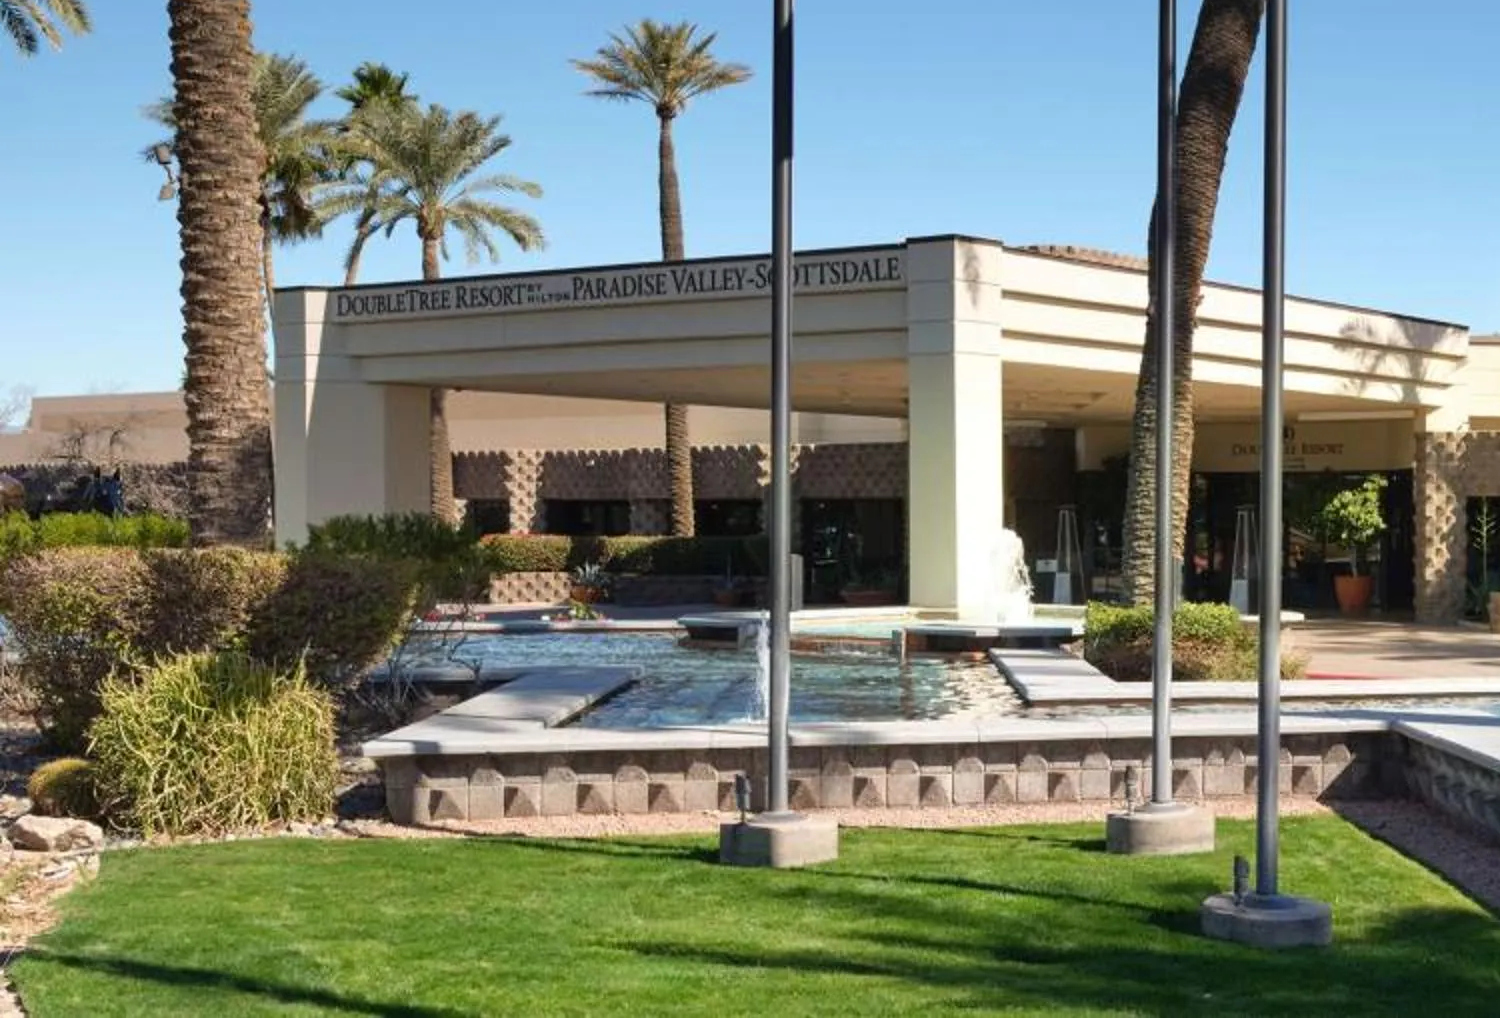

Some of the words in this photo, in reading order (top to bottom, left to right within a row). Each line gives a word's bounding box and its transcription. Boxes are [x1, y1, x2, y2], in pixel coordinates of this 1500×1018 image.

[455, 284, 524, 308] RESORT
[527, 283, 543, 292] BY
[527, 291, 571, 303] HILTON
[573, 273, 667, 301] PARADISE
[337, 289, 451, 316] DOUBLETREE
